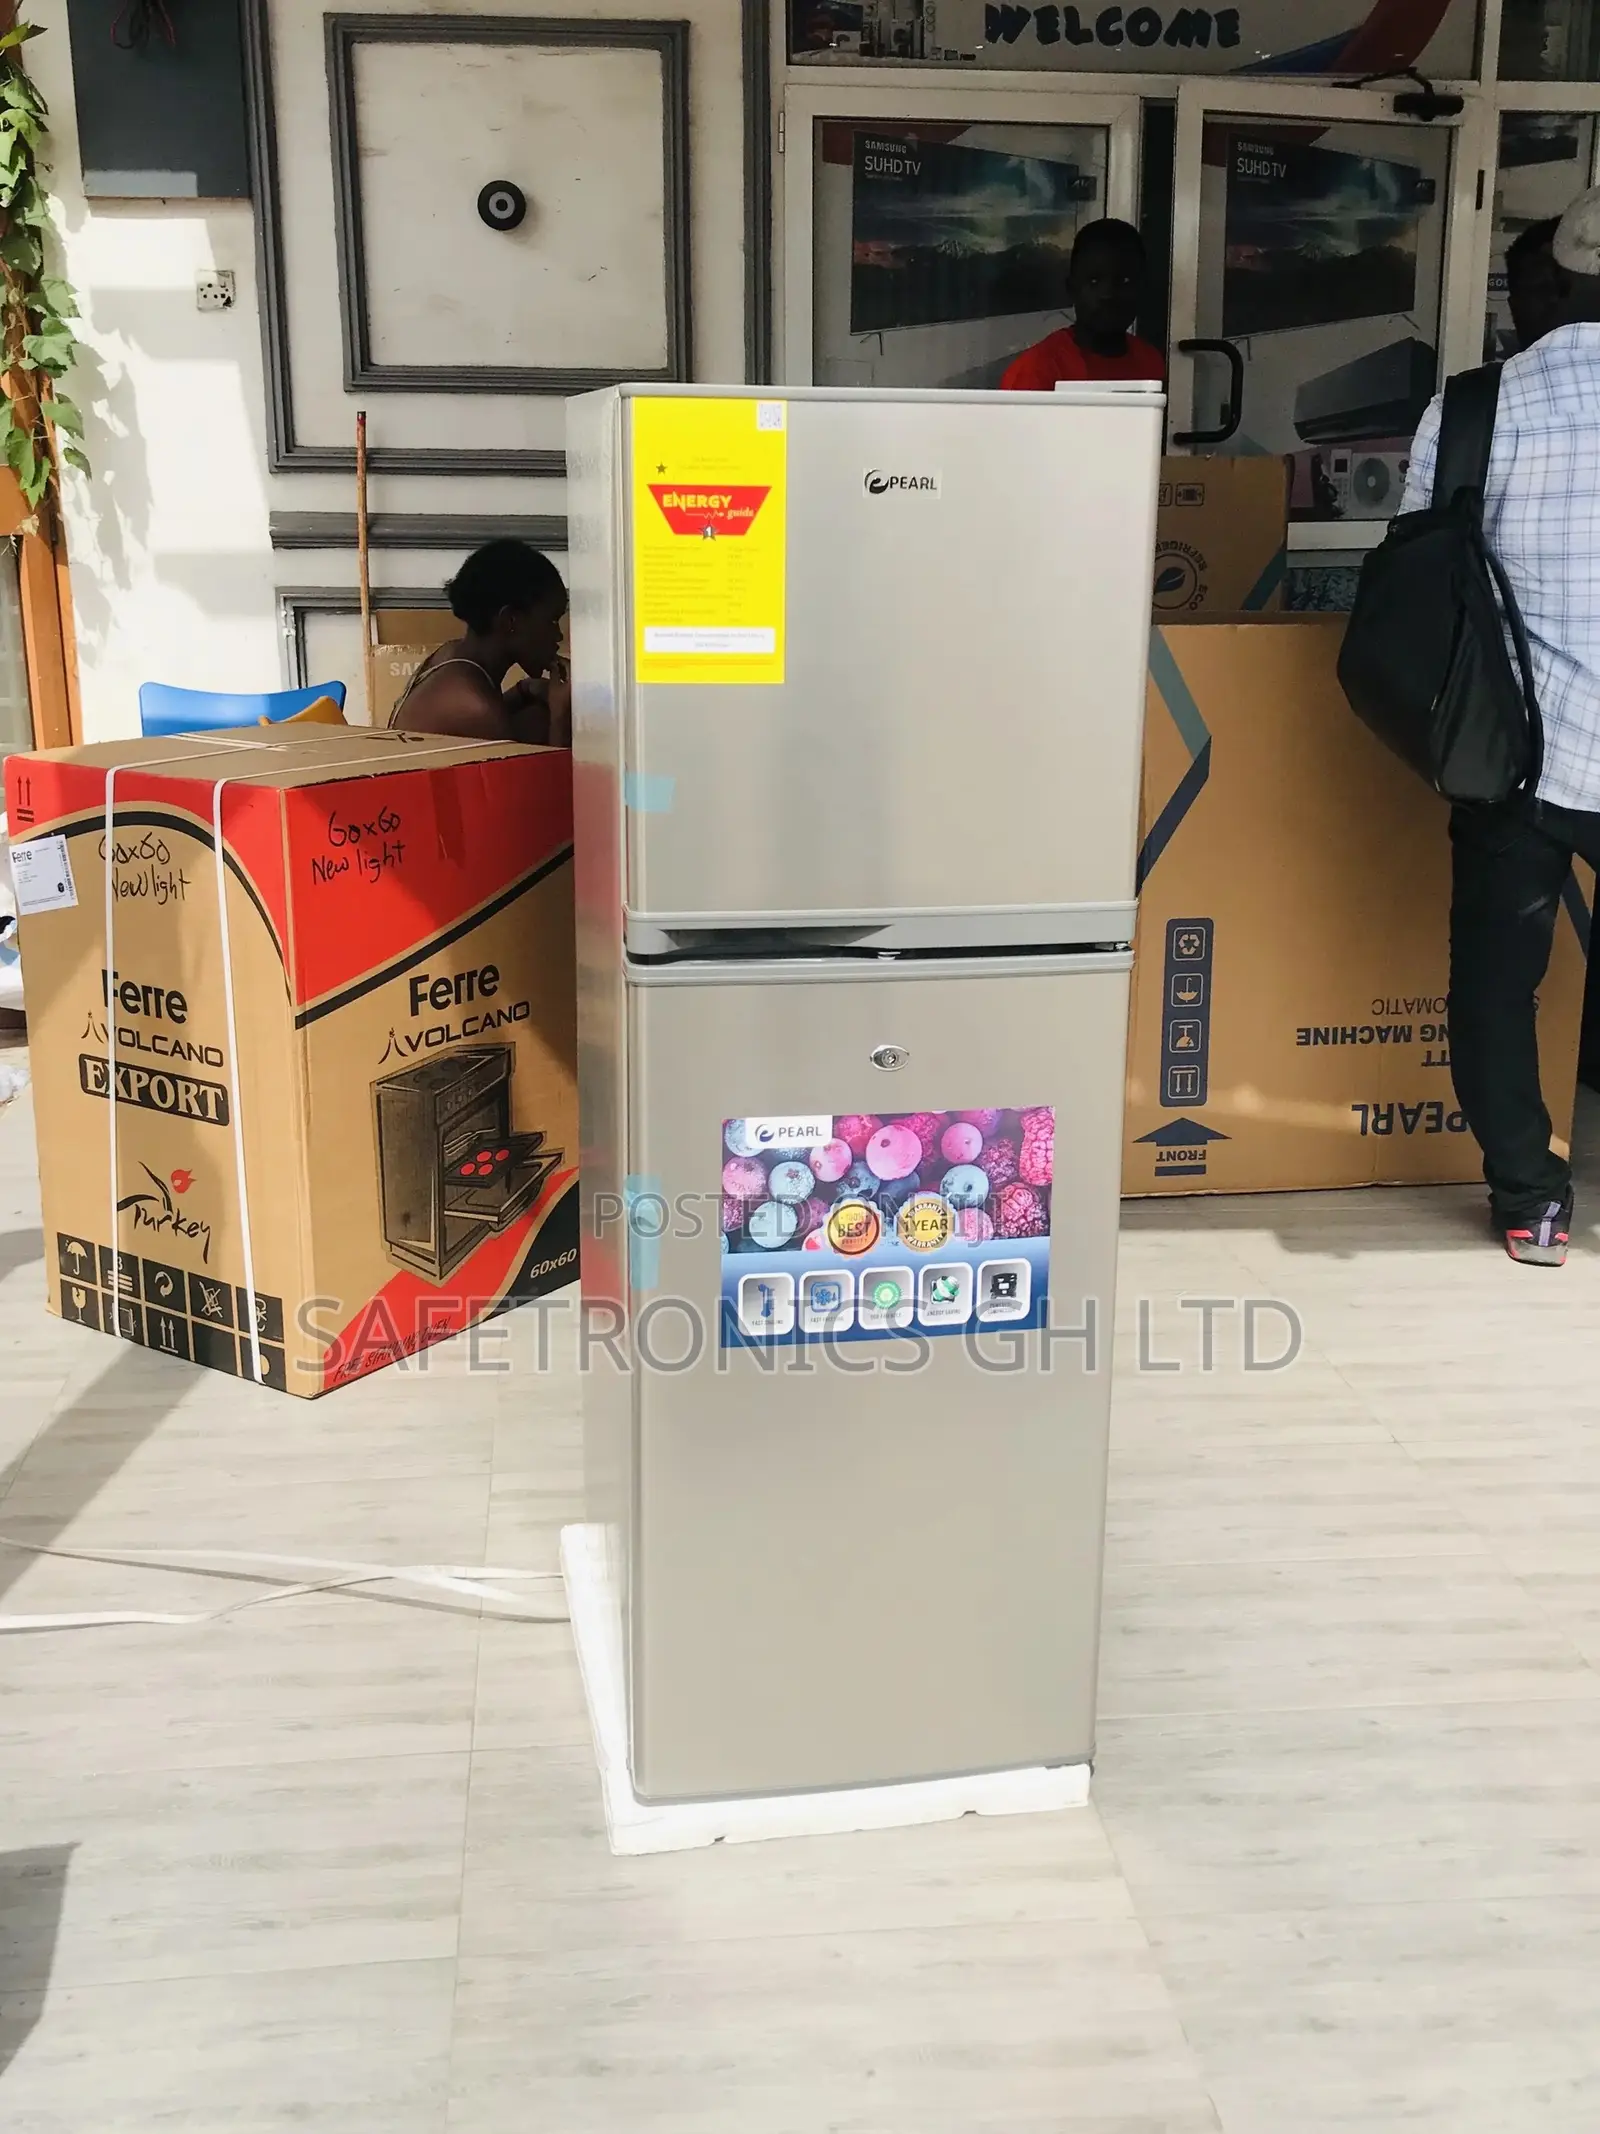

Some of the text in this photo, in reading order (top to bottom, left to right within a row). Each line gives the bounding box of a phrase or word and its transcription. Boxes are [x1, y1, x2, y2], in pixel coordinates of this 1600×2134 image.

[984, 4, 1240, 48] WELCOME
[864, 139, 907, 154] SAMSUNG
[889, 475, 938, 491] PEARL
[662, 491, 733, 513] ENERGY
[726, 507, 755, 520] guide
[11, 850, 33, 864] Ferre
[311, 839, 406, 886] New light
[151, 863, 192, 906] light
[101, 968, 189, 1025] Ferre
[408, 964, 501, 1018] Ferre
[404, 1000, 531, 1053] VOLCANO
[1296, 1025, 1413, 1046] MACHINE
[83, 1057, 225, 1122] EXPORT
[1351, 1100, 1471, 1136] PEARL
[778, 1126, 824, 1138] PEARL
[1155, 1149, 1207, 1162] FRONT
[906, 1202, 947, 1219] WARRANTY
[125, 1197, 212, 1265] Turkey
[837, 1221, 872, 1238] BEST
[913, 1218, 948, 1232] YEAR
[906, 1232, 947, 1248] WARRANTY
[529, 1247, 578, 1280] 60x60
